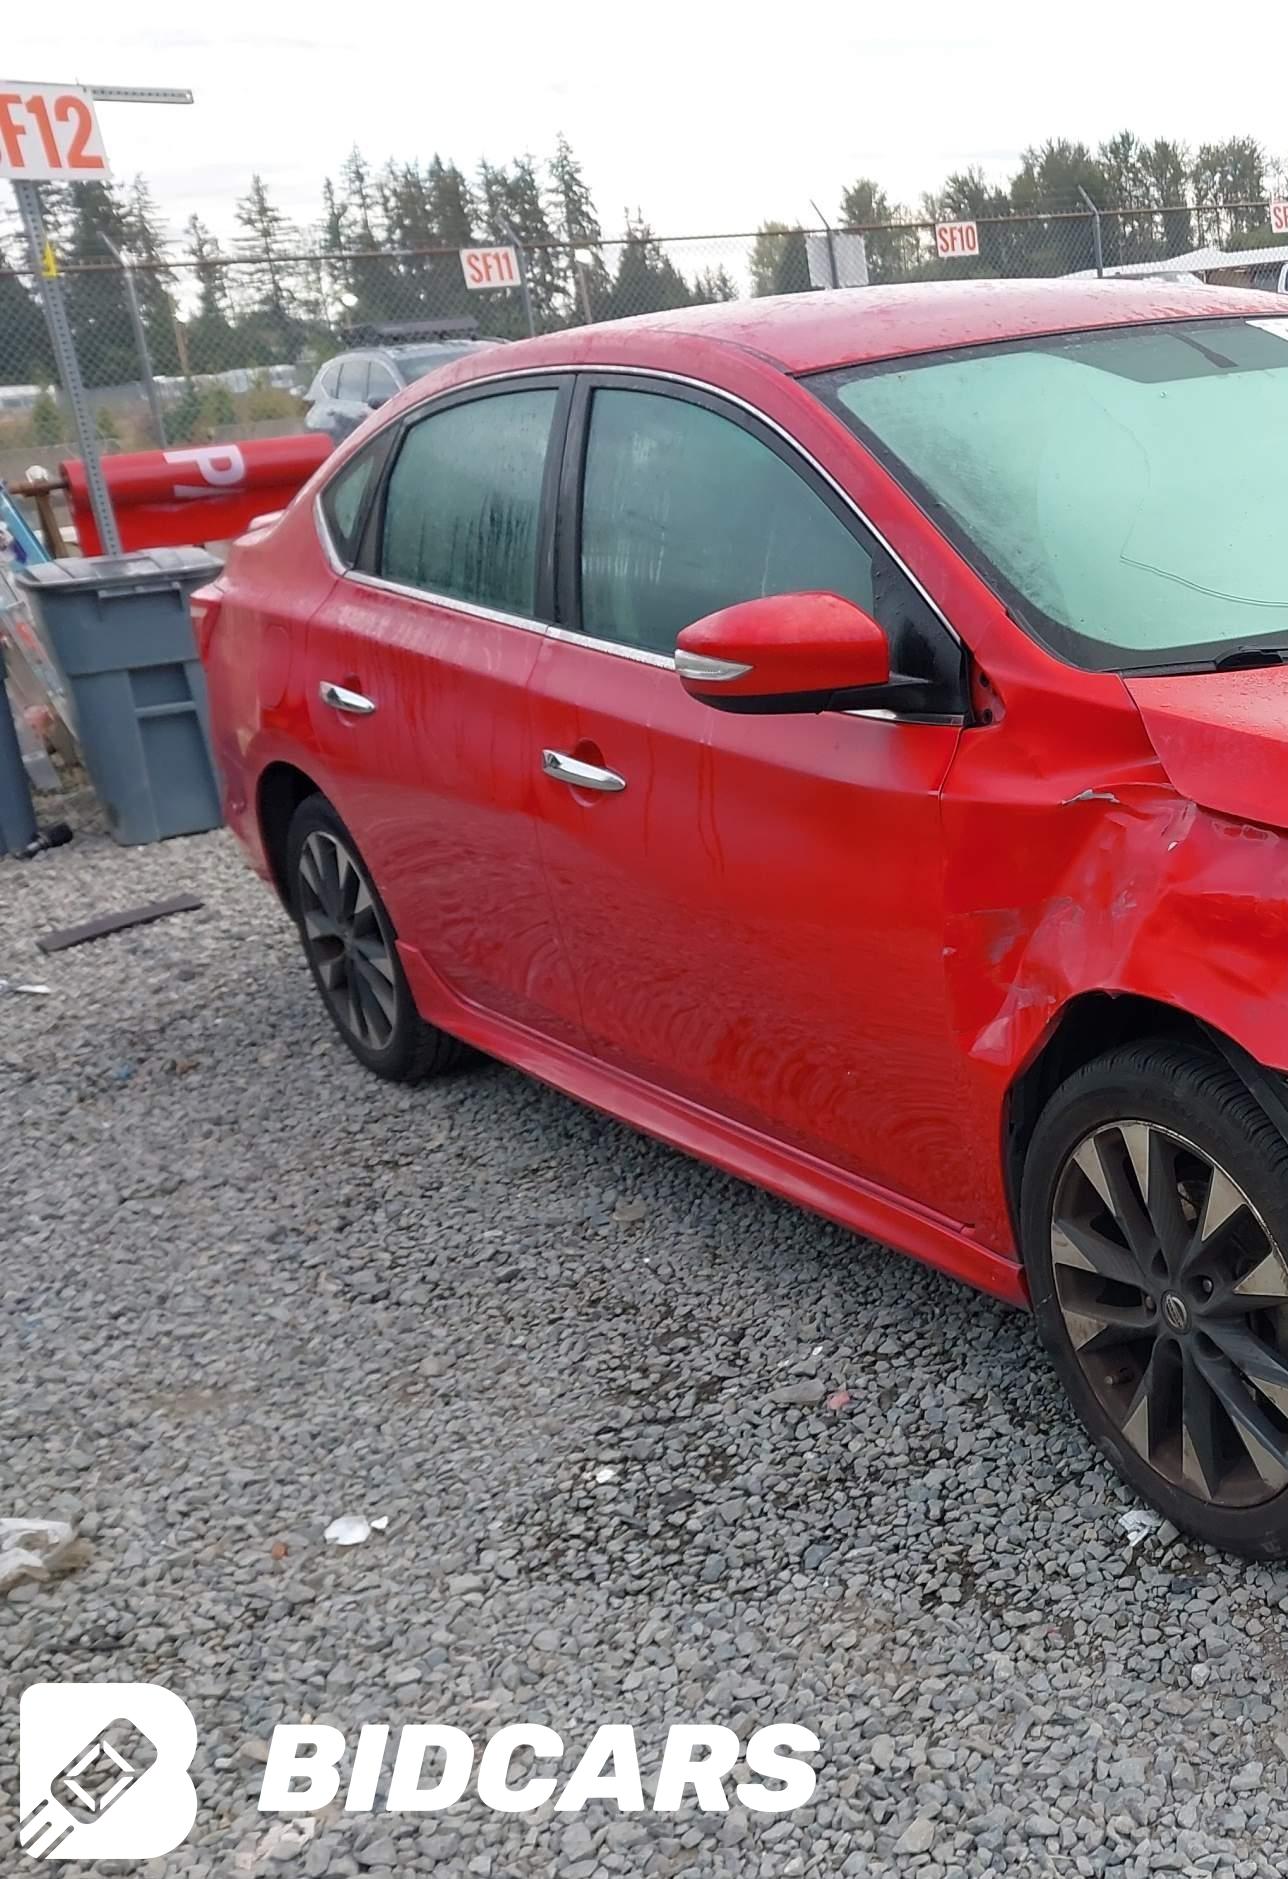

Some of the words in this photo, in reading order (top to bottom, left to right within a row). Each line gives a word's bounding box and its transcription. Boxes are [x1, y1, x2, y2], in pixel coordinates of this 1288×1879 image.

[0, 93, 105, 169] F12
[938, 224, 976, 252] SF10
[467, 251, 513, 283] SF11
